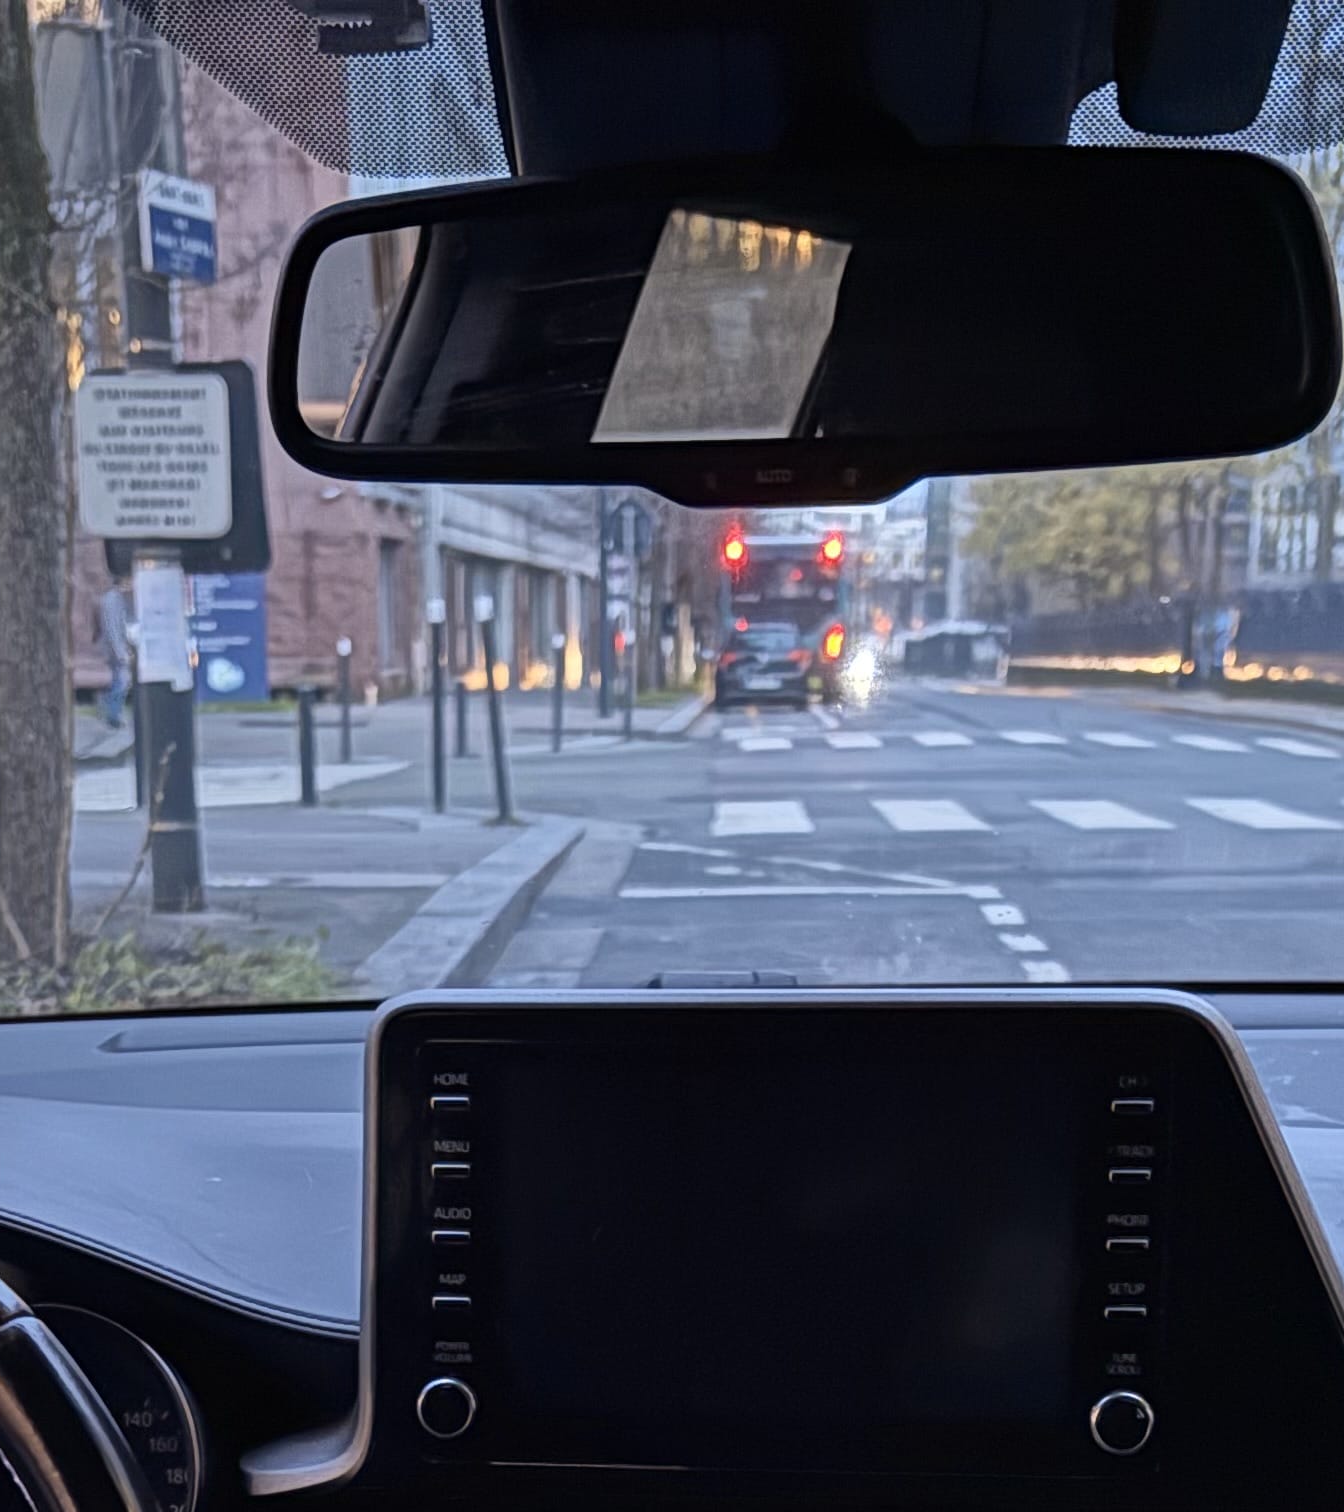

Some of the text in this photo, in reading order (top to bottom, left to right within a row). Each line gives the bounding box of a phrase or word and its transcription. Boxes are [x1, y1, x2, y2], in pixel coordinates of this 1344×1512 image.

[755, 469, 792, 483] AUTO
[434, 1073, 469, 1086] HOME
[434, 1140, 470, 1153] MENU
[434, 1207, 471, 1220] AUDIO
[1108, 1282, 1145, 1296] SETUP
[122, 1412, 152, 1428] 140
[149, 1437, 178, 1453] 160
